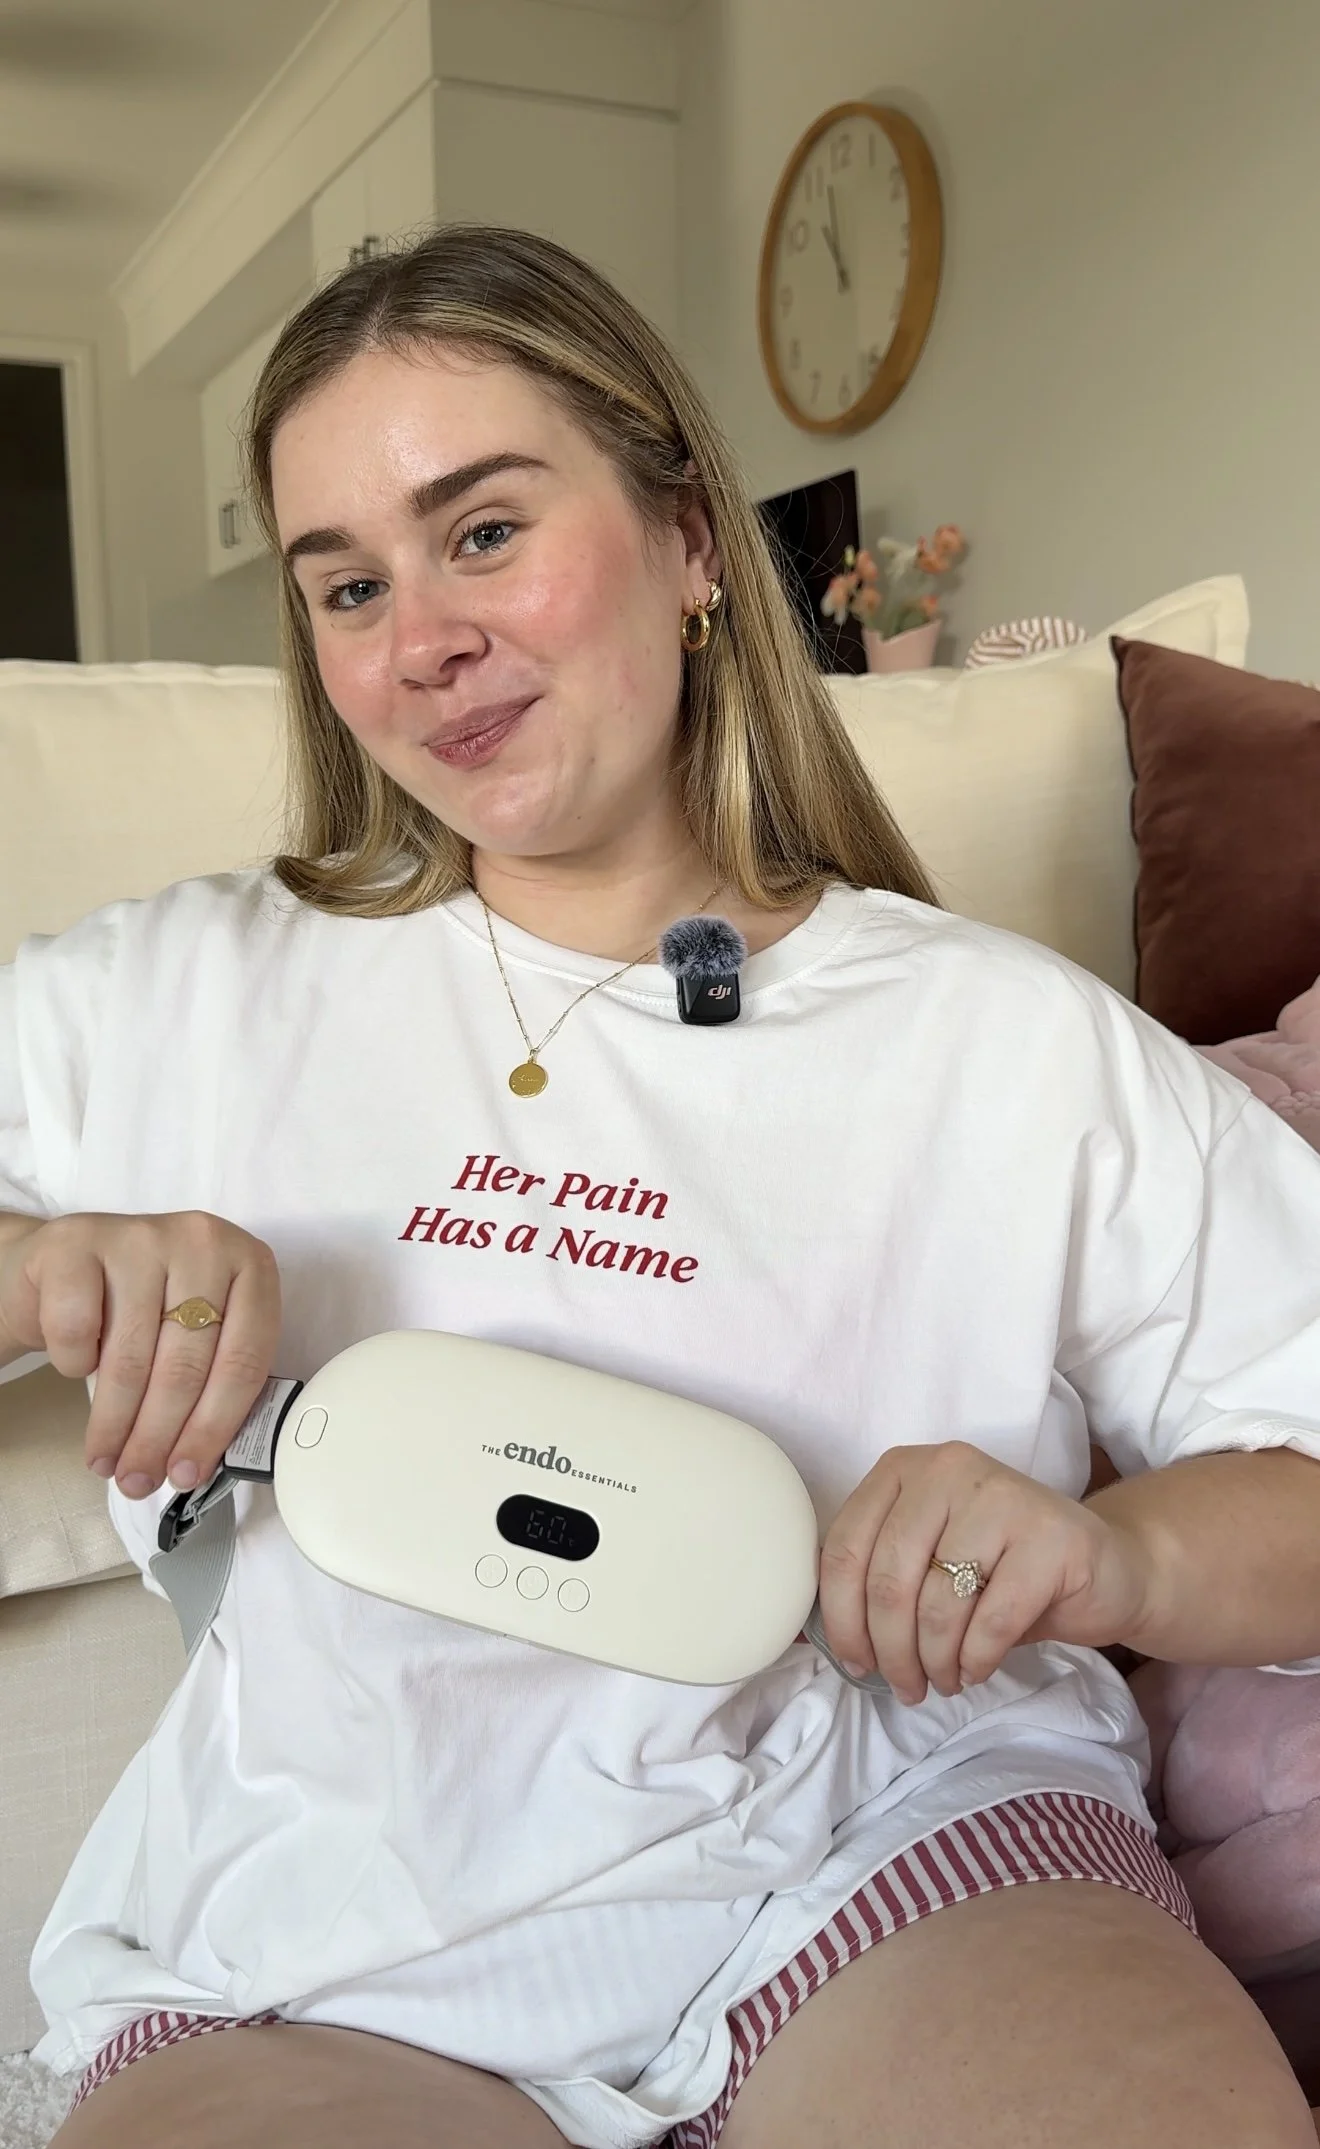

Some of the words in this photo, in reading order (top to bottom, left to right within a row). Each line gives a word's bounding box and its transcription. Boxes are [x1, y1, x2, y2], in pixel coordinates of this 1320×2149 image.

[830, 134, 852, 174] 12
[804, 165, 824, 204] 11
[707, 984, 731, 999] dji
[450, 1154, 546, 1195] Her
[549, 1172, 668, 1220] Pain
[398, 1206, 497, 1249] Has
[504, 1224, 539, 1253] a
[545, 1227, 699, 1283] Name
[481, 1444, 501, 1456] THE
[503, 1441, 572, 1474] endo
[571, 1469, 637, 1493] ESSENTIALS
